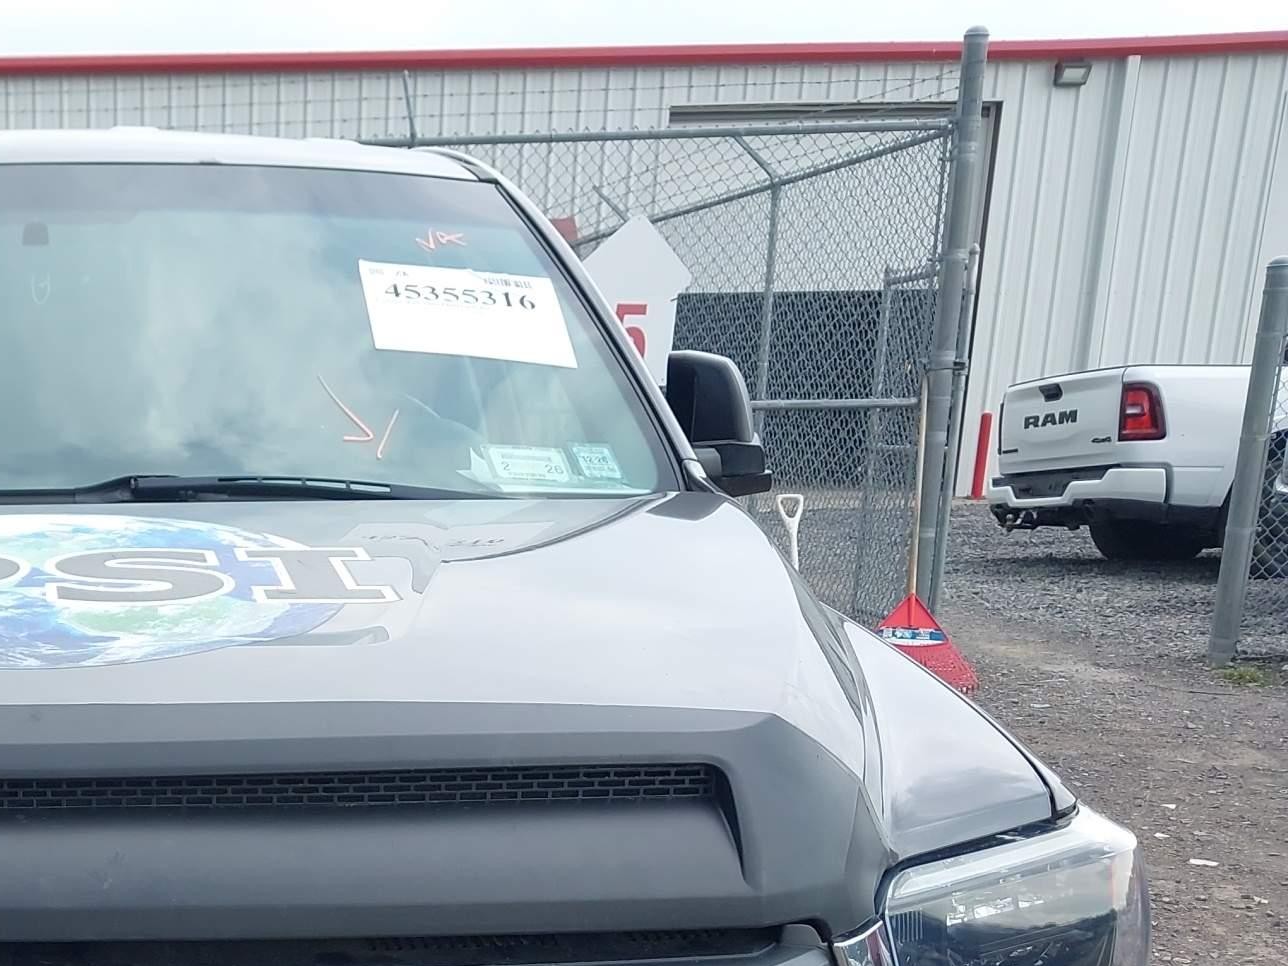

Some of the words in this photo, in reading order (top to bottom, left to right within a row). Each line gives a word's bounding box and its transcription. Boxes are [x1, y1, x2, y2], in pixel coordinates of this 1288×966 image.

[384, 283, 536, 310] 45355316
[616, 304, 647, 359] 5
[1024, 409, 1078, 429] RAM
